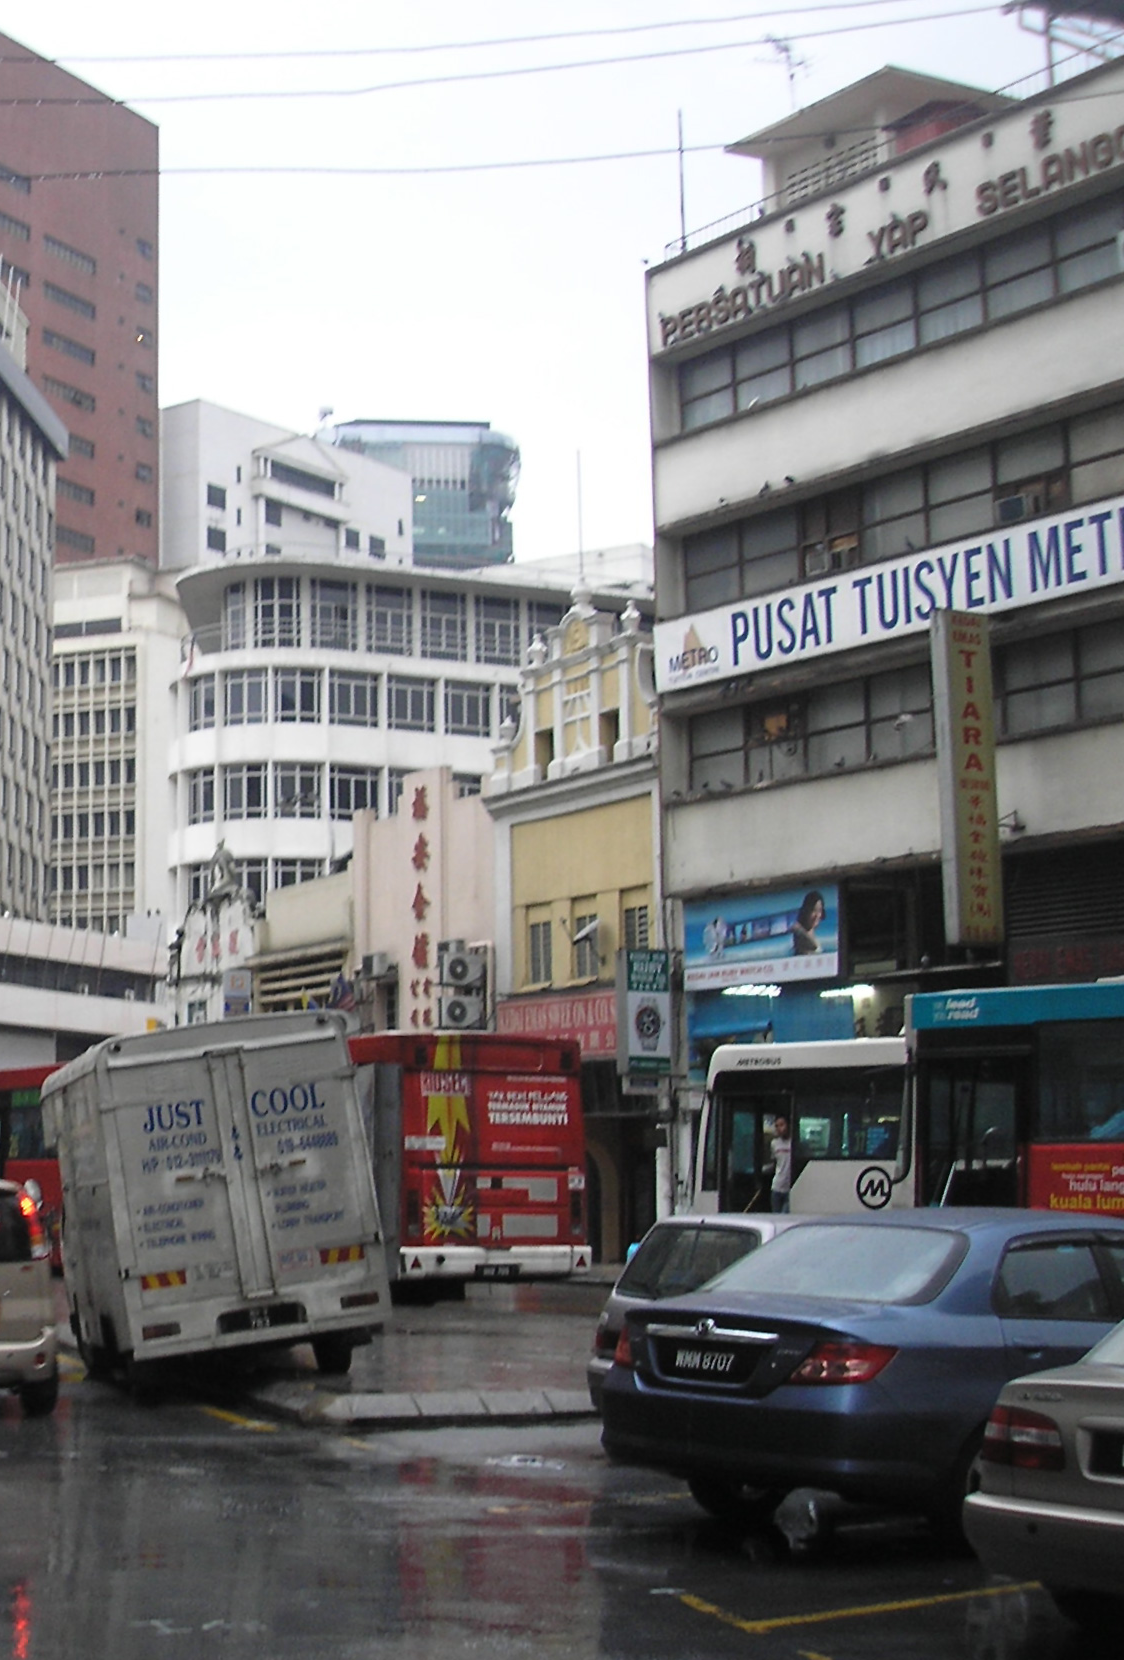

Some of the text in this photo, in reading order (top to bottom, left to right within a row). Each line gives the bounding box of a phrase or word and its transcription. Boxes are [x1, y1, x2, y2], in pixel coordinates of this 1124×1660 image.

[659, 253, 826, 347] PERSATUAN
[867, 211, 930, 260] YAP
[731, 508, 1124, 667] PUSAT TUISYEN MET
[668, 646, 719, 673] METRO
[251, 1083, 325, 1118] COOL
[143, 1101, 206, 1134] JUST
[257, 1115, 328, 1137] ELECTRICAL
[487, 1112, 569, 1125] TERSEMBUNYI
[1069, 1179, 1097, 1192] hulu
[1050, 1193, 1092, 1209] kuala
[702, 1352, 735, 1372] 8707
